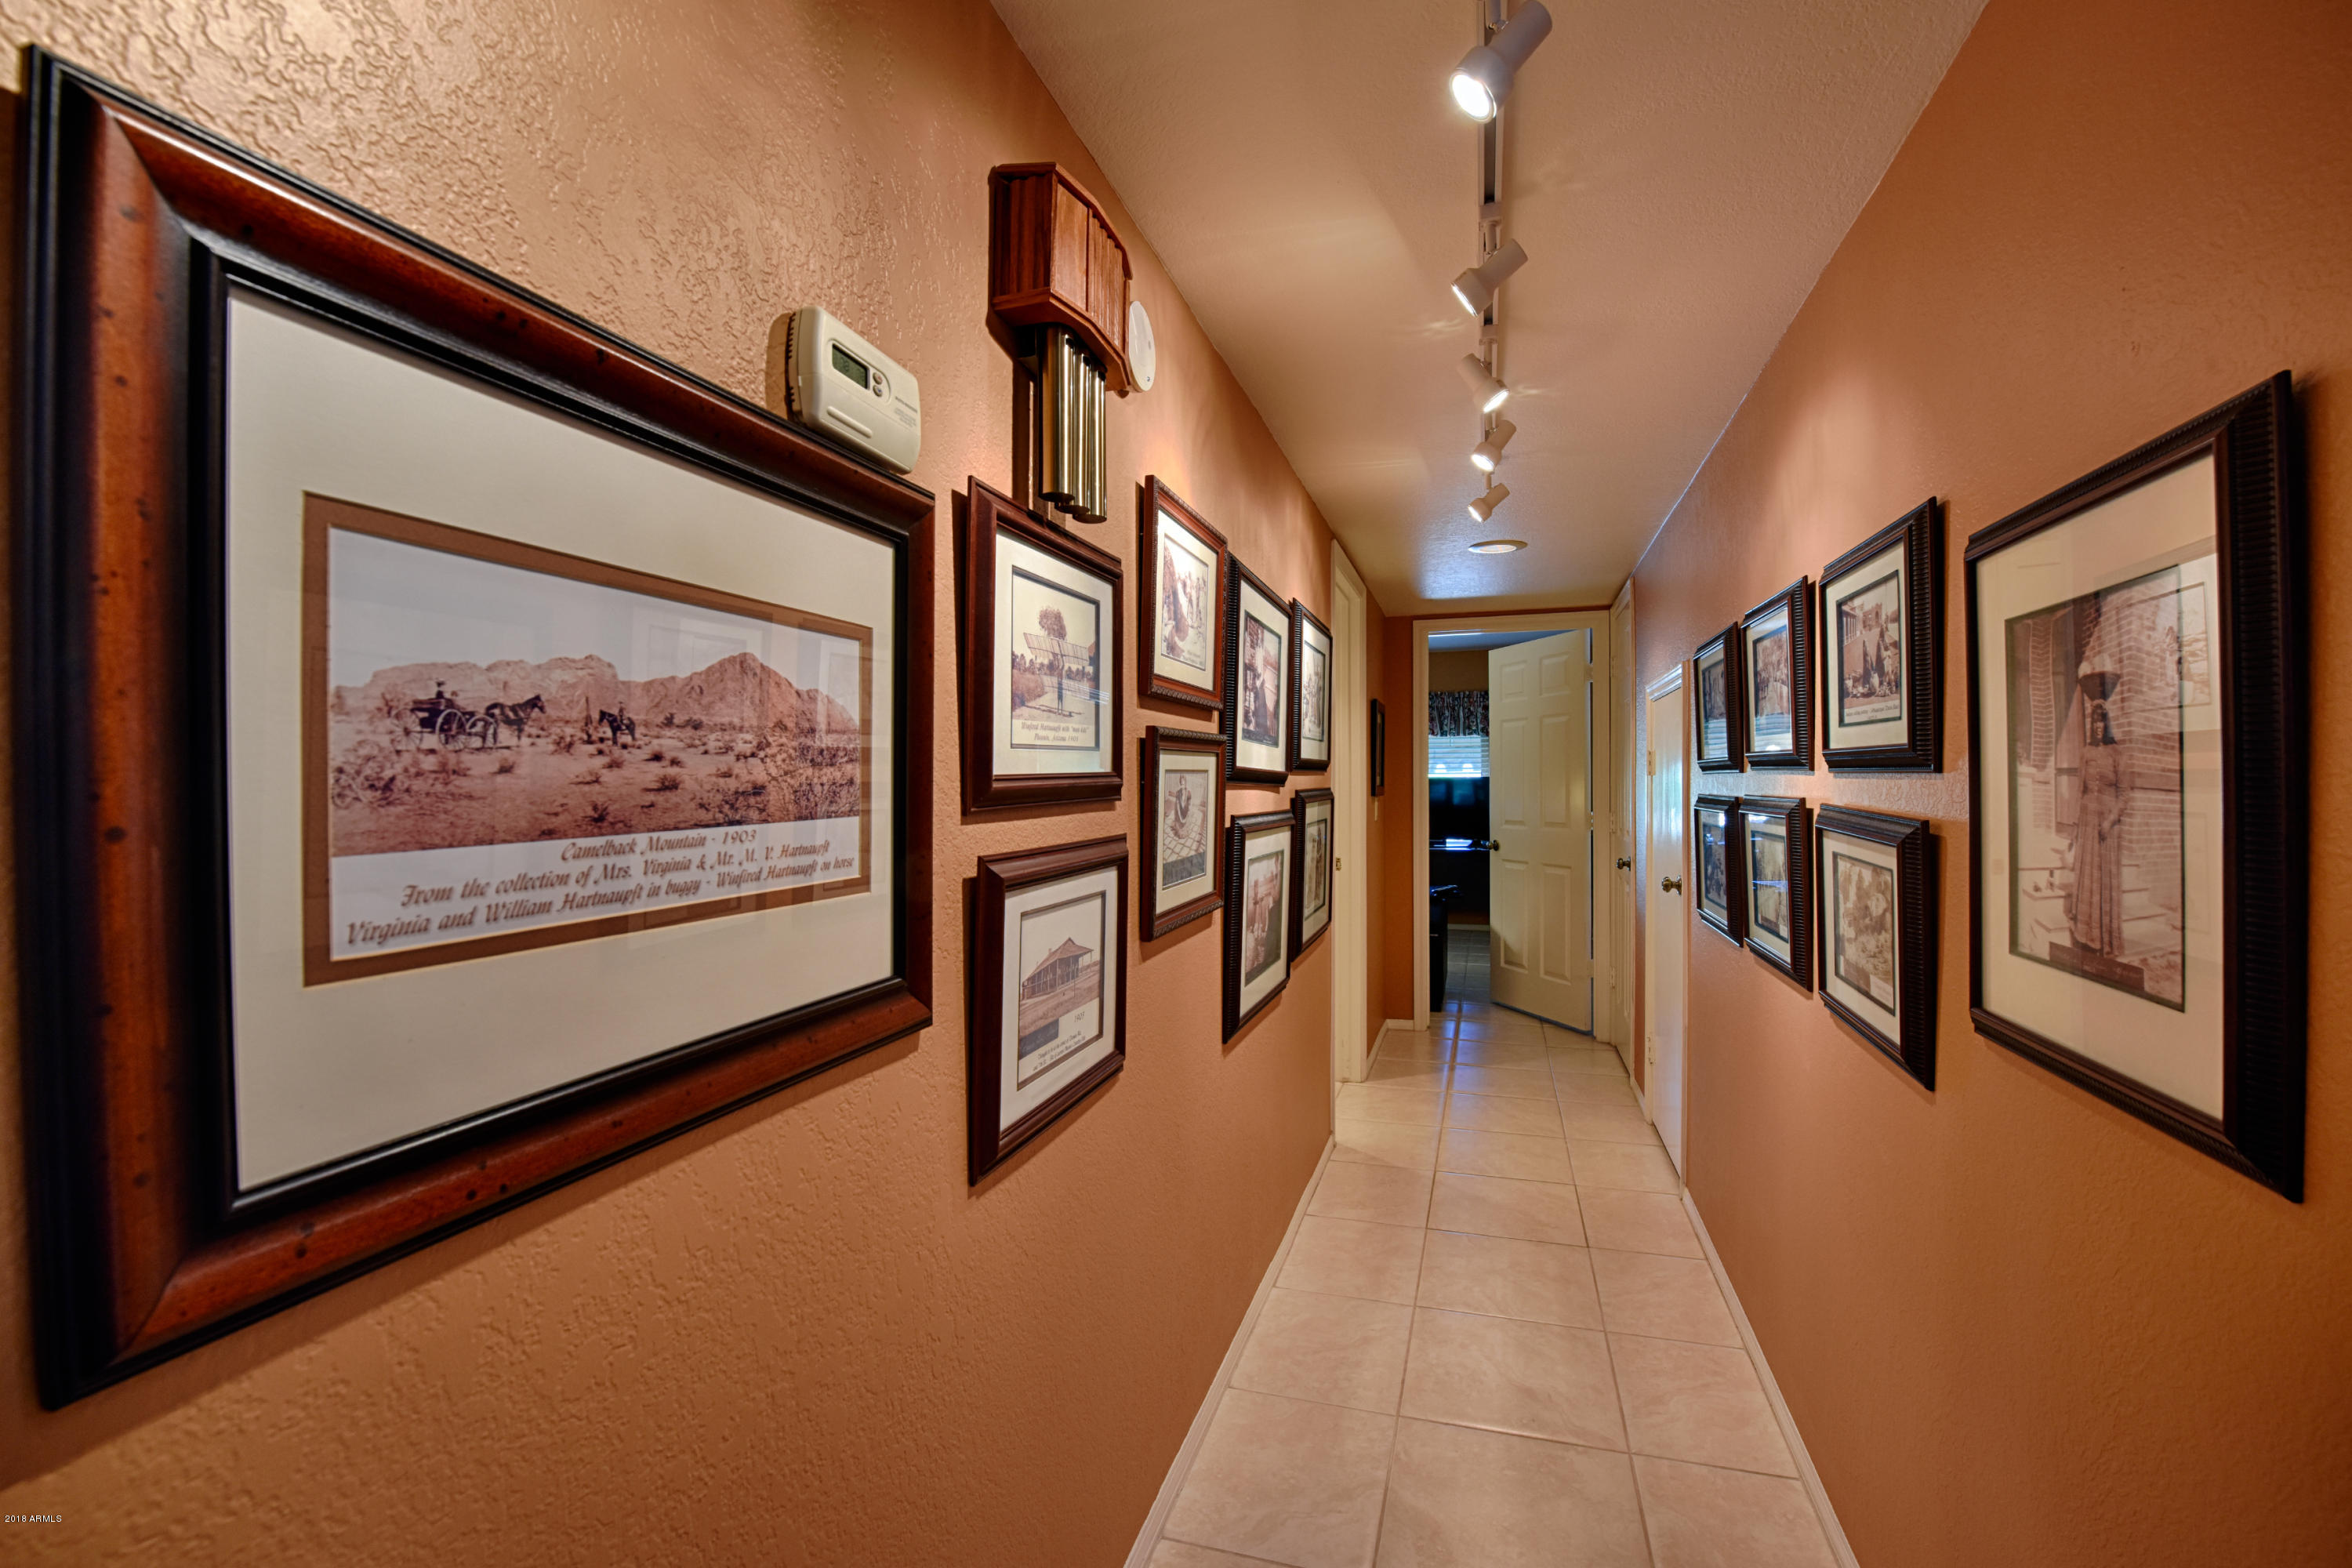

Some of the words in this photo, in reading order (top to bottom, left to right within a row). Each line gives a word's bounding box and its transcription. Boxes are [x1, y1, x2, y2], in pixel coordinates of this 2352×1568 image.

[561, 837, 637, 862] Camelback
[640, 833, 707, 856] Mountain
[722, 829, 757, 846] 1903
[347, 914, 430, 946] Virginia
[437, 902, 477, 931] and
[485, 898, 554, 924] William
[646, 881, 662, 898] in
[664, 878, 702, 898] buggy
[819, 861, 832, 872] on
[833, 855, 855, 870] horse
[401, 884, 454, 907] From
[460, 877, 491, 899] the
[495, 870, 571, 895] collection
[575, 865, 593, 887] of
[593, 863, 632, 885] Mrs.
[642, 855, 692, 878] Virginia
[695, 854, 707, 871] &
[710, 851, 735, 870] Mr.
[739, 848, 758, 867] M.
